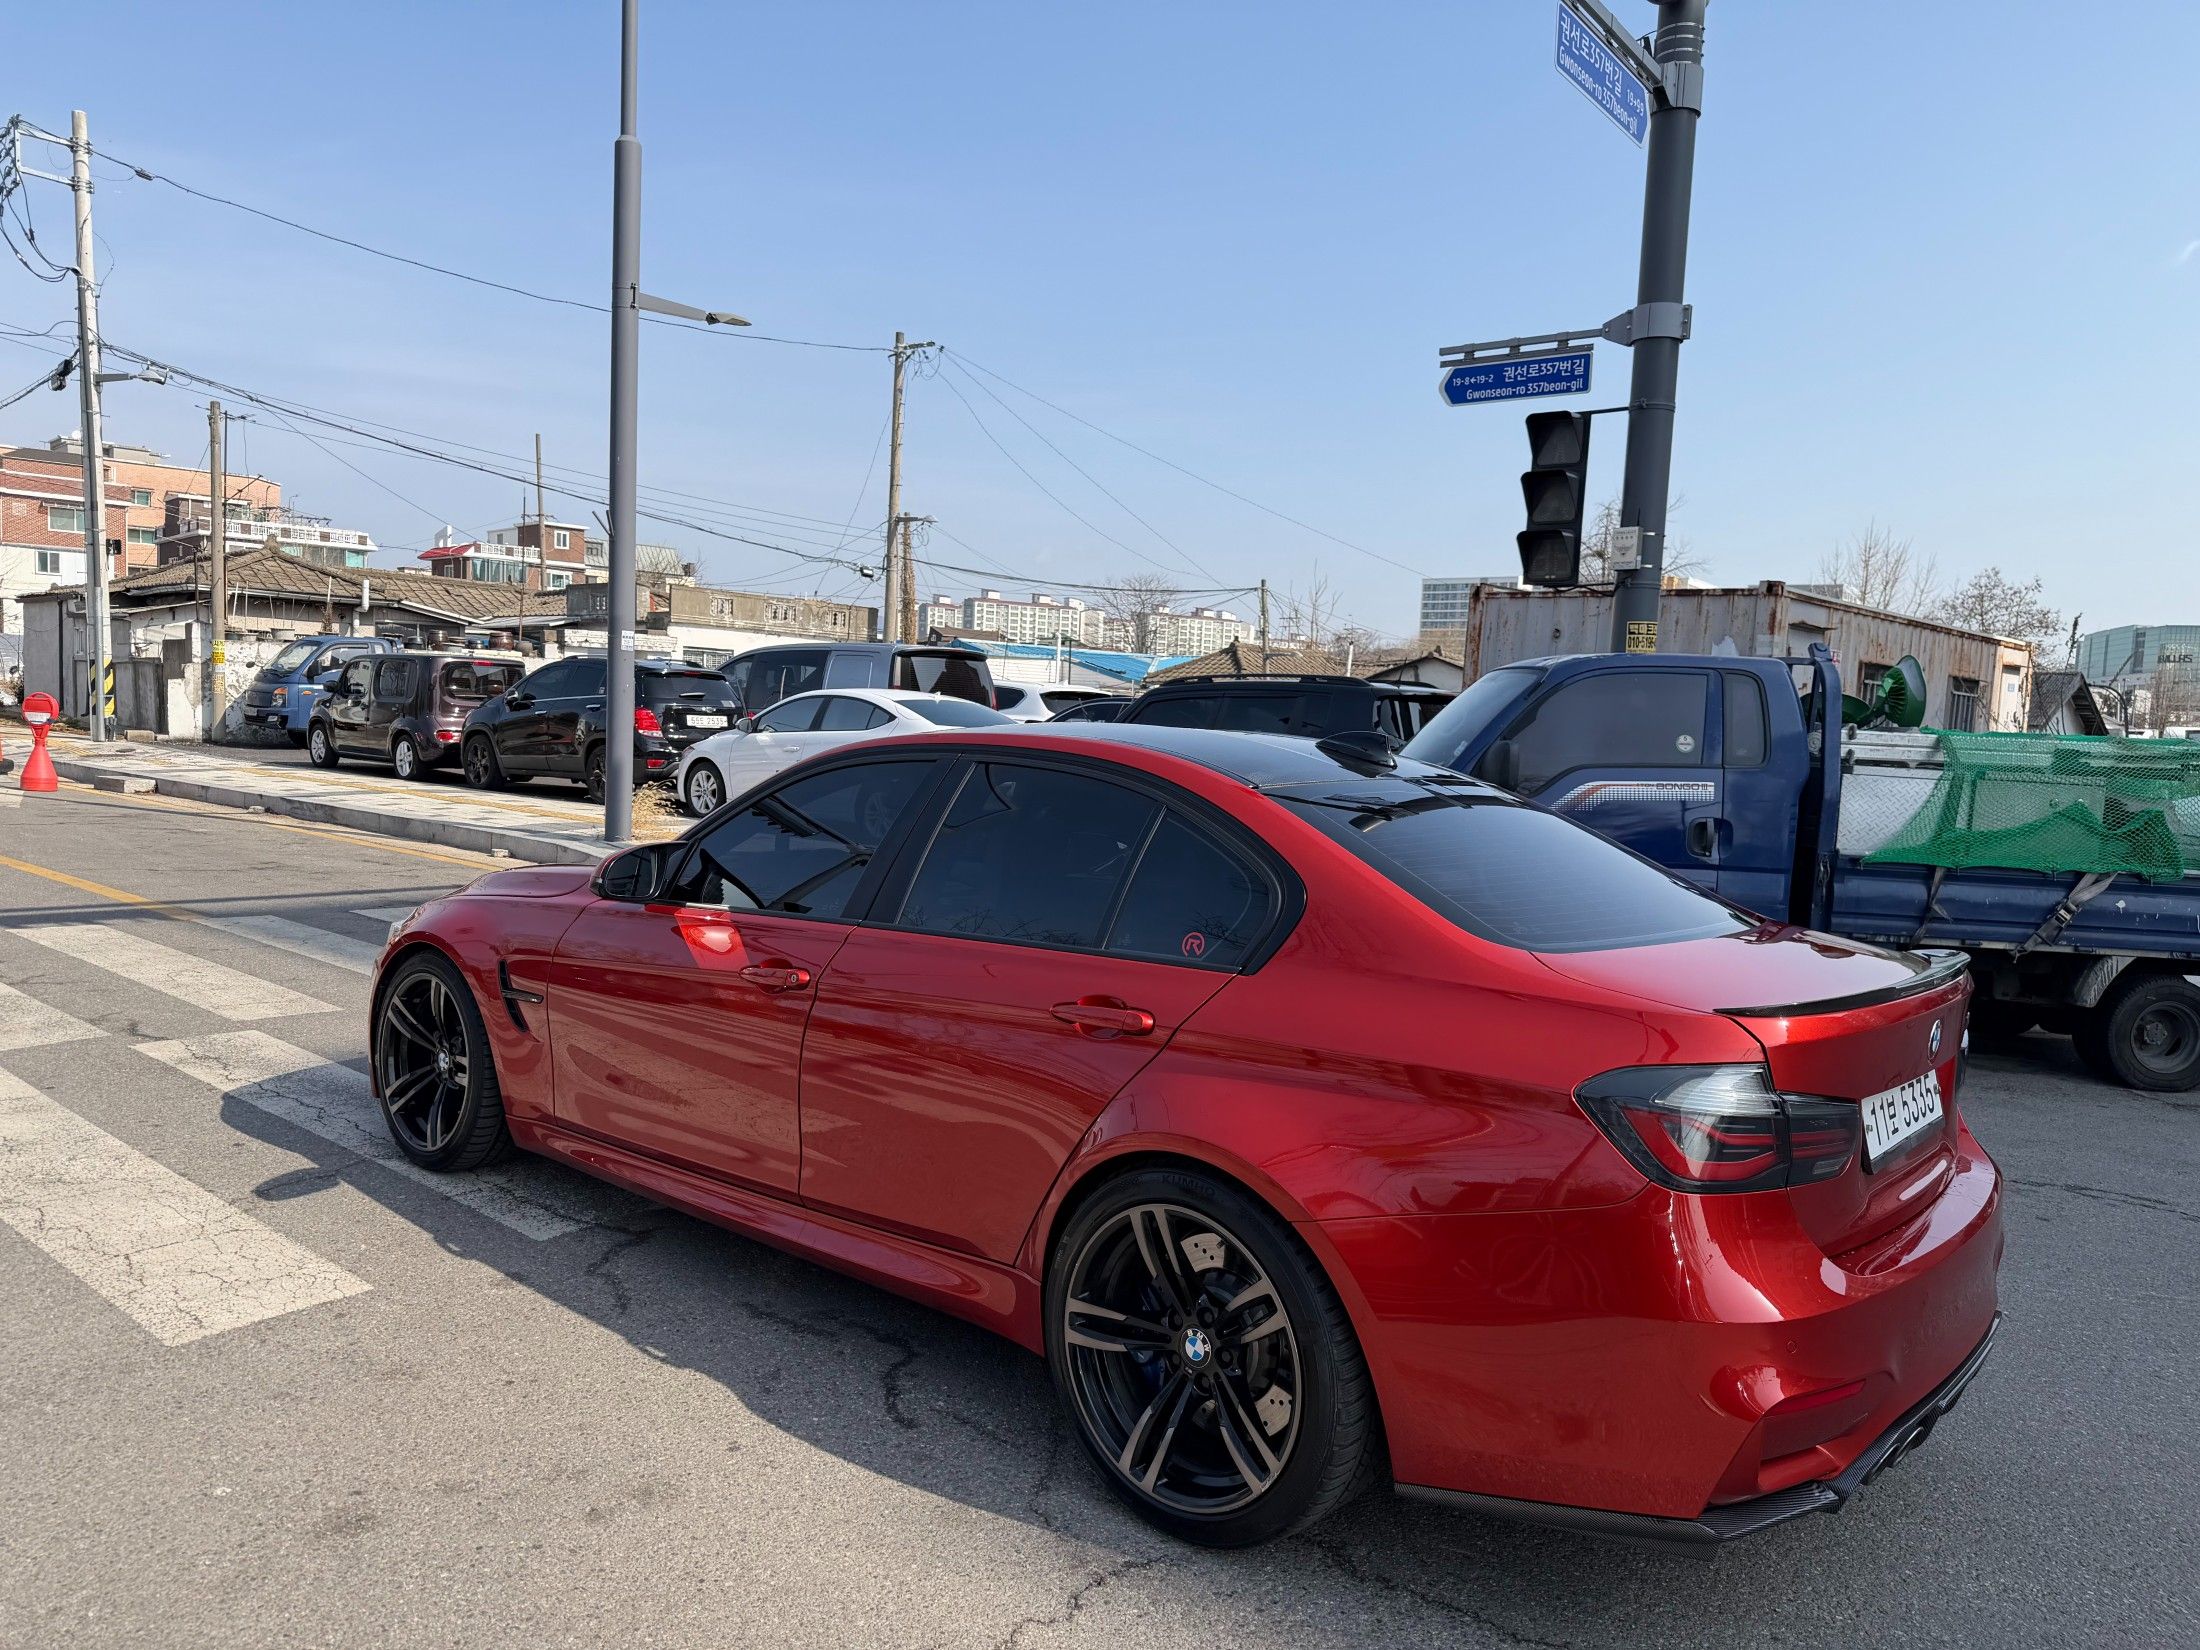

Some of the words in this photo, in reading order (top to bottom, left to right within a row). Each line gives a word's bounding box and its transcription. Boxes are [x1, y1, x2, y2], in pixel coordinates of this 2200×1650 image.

[1561, 12, 1622, 97] 권선로357번길
[1560, 46, 1602, 100] Gwonseon-ro
[1603, 87, 1637, 134] 357beon-gil
[1467, 386, 1526, 400] Gwonseon-ro
[1527, 378, 1583, 394] 357beon-gil
[1503, 359, 1584, 382] 권선로357번길
[1900, 1074, 1935, 1127] 5335
